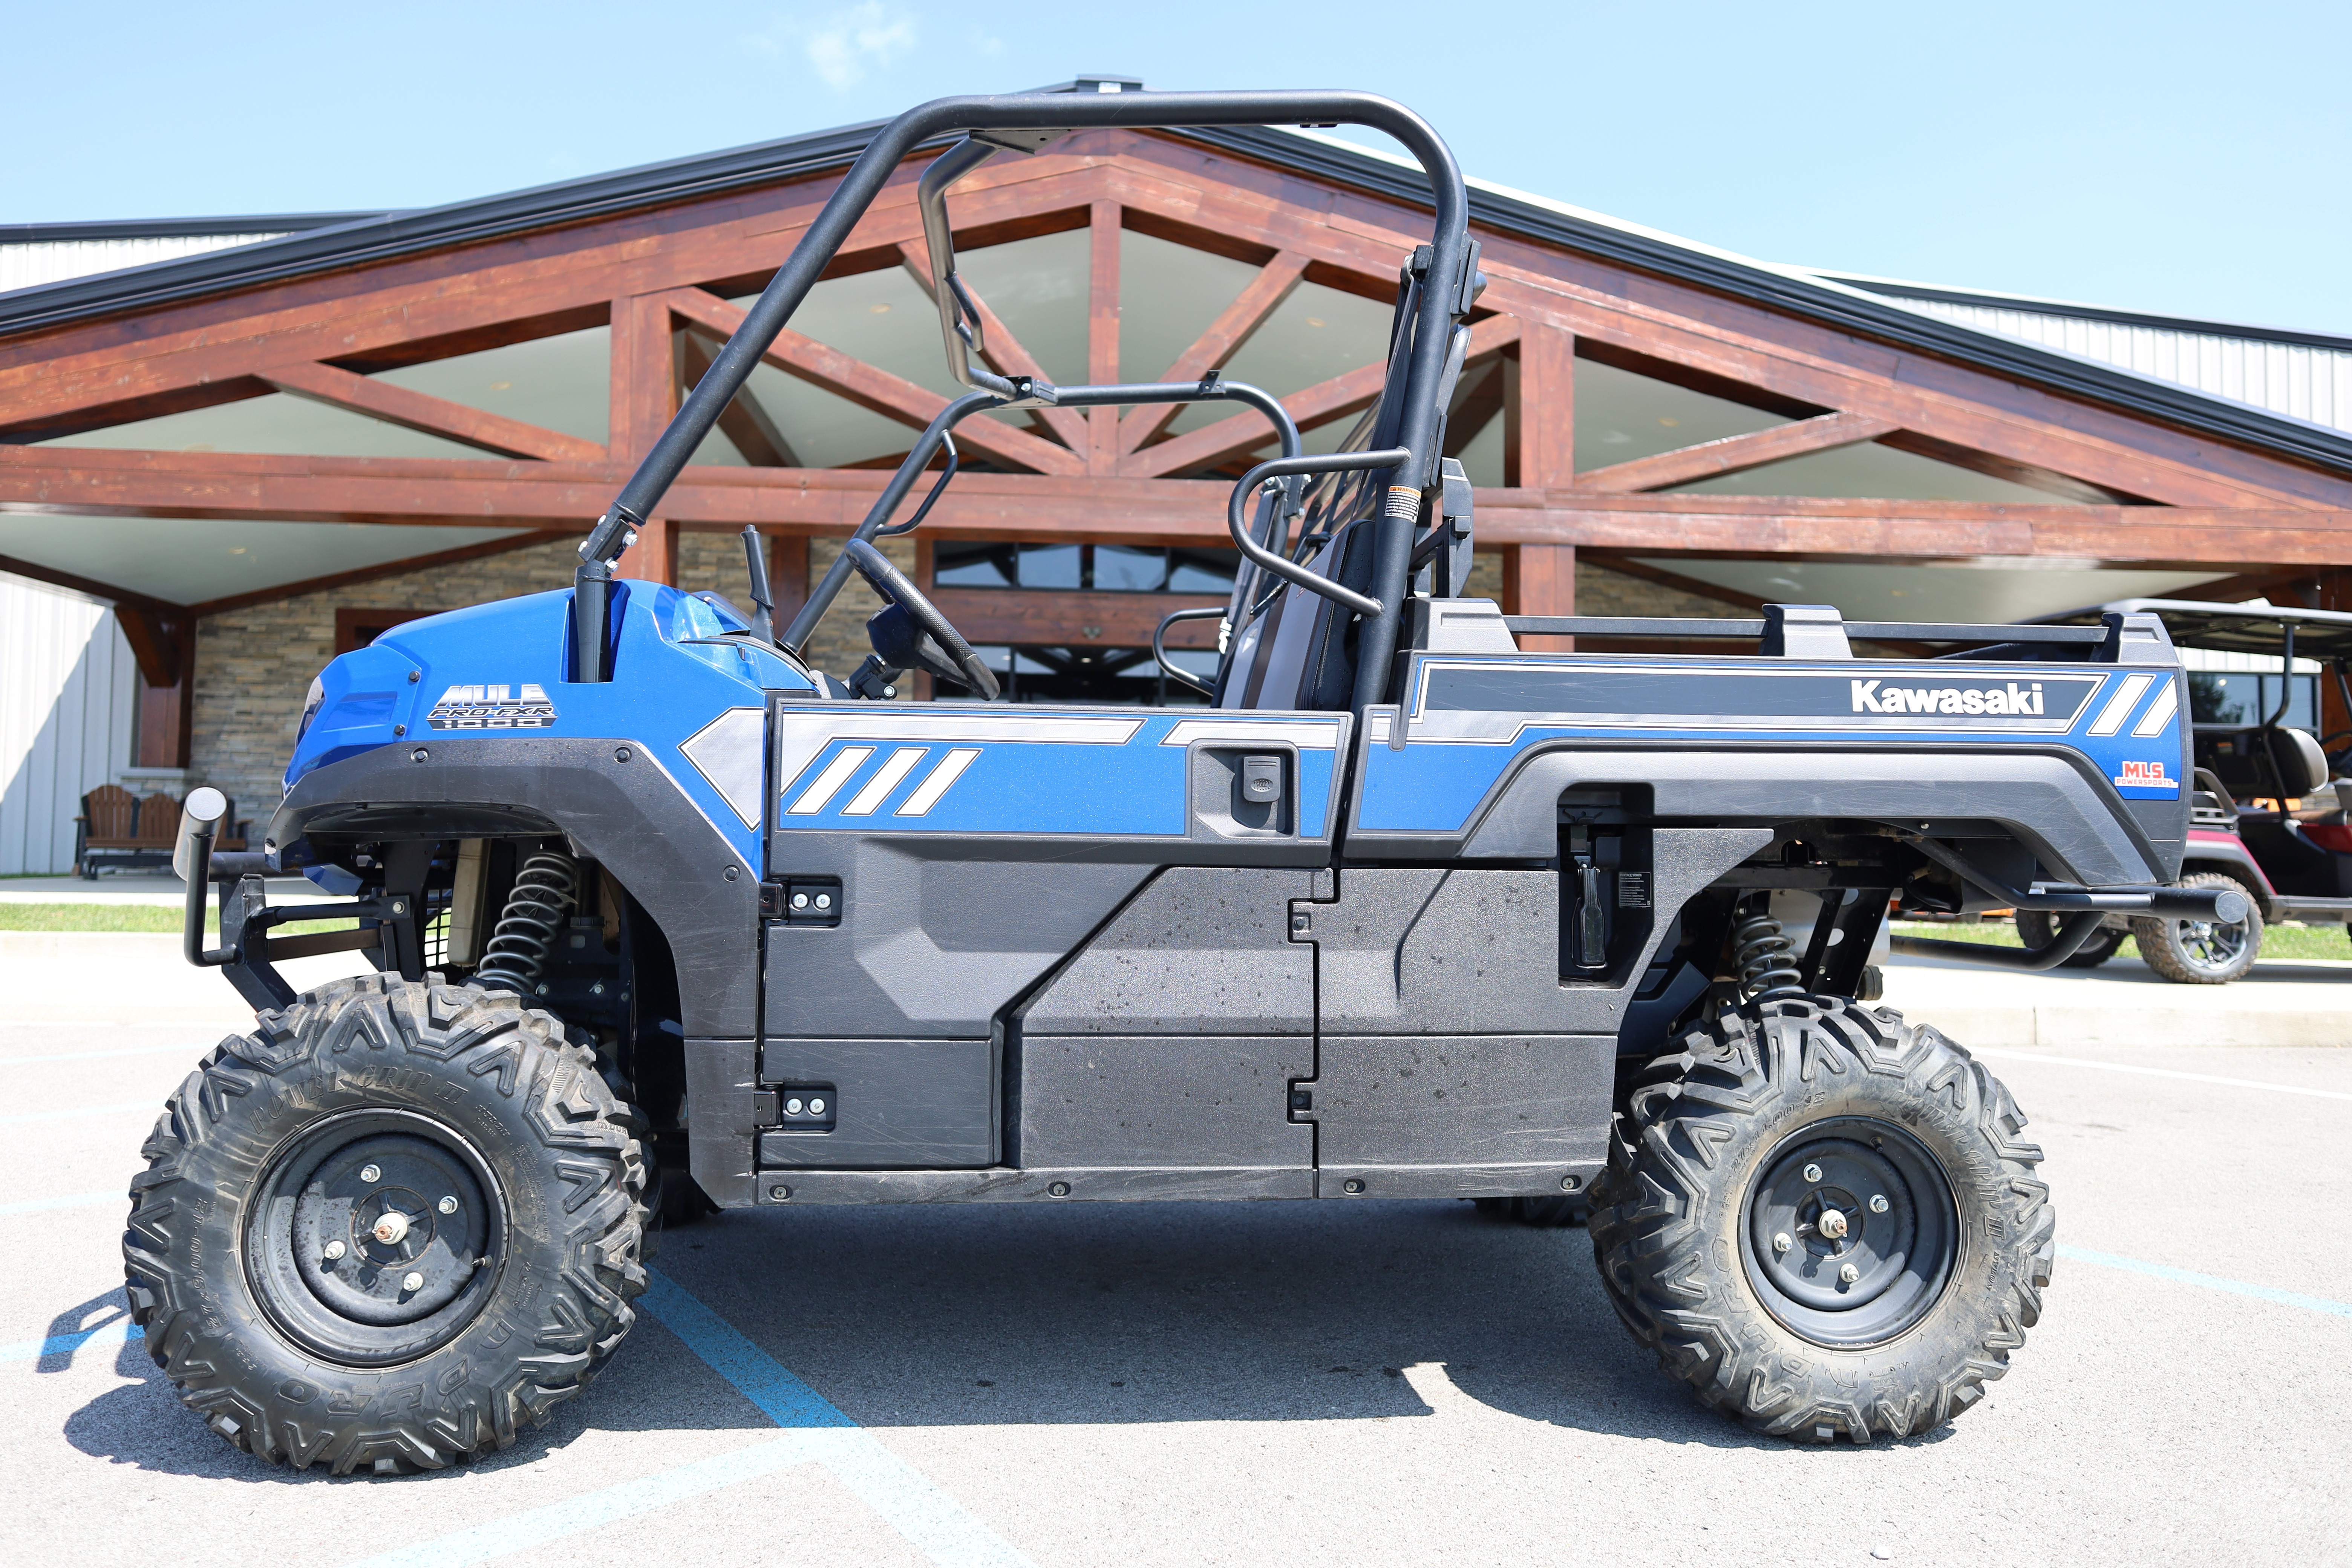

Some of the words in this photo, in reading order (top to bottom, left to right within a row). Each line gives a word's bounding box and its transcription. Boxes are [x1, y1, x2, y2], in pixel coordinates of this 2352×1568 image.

[1398, 487, 1419, 496] WARNING
[427, 706, 558, 718] PRO-FXR
[434, 684, 553, 707] MULE
[1850, 680, 2044, 715] Kawasaki
[443, 719, 542, 728] 1000
[2124, 763, 2162, 778] MLS
[248, 1068, 345, 1135] POWER
[357, 1066, 433, 1090] GRIP
[433, 1080, 469, 1106] II
[474, 1103, 511, 1137] NYLON
[1886, 1090, 1971, 1144] POWER
[1961, 1149, 2001, 1209] GRIP
[524, 1154, 538, 1176] VEHICLE
[534, 1177, 543, 1192] LABEL
[539, 1194, 546, 1204] OR
[188, 1197, 222, 1329] 27x9.00-12
[1985, 1251, 2000, 1292] NYLON
[1712, 1237, 1811, 1378] DURO
[276, 1355, 470, 1418] DURO
